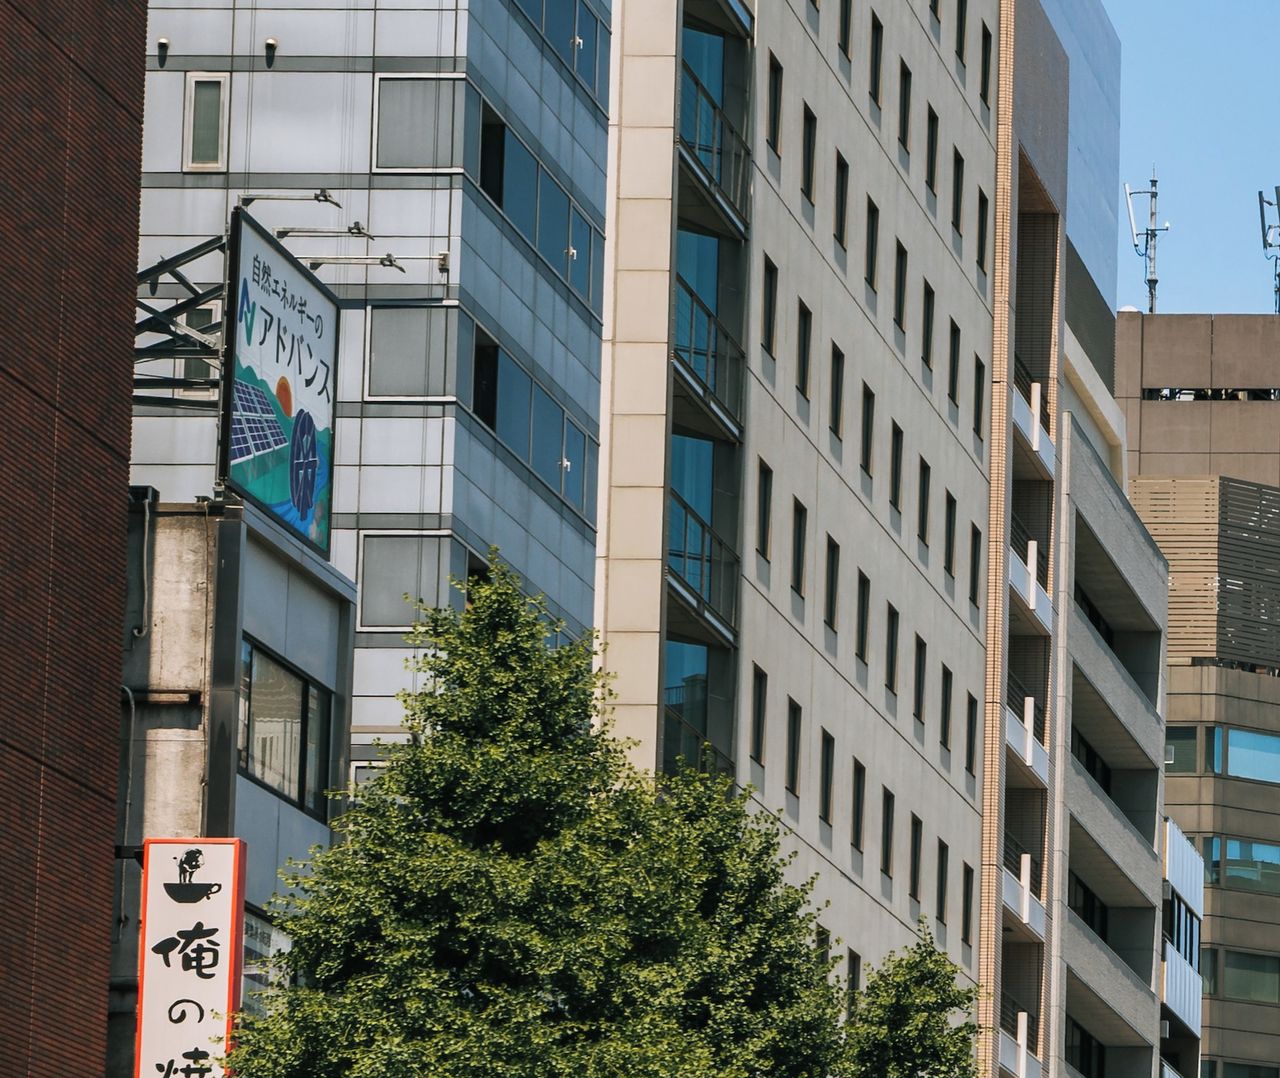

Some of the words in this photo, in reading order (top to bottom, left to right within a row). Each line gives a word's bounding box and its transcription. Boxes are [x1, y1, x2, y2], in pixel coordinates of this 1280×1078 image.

[252, 254, 323, 339] 自然エネルギーの
[259, 305, 330, 404] アドバンス
